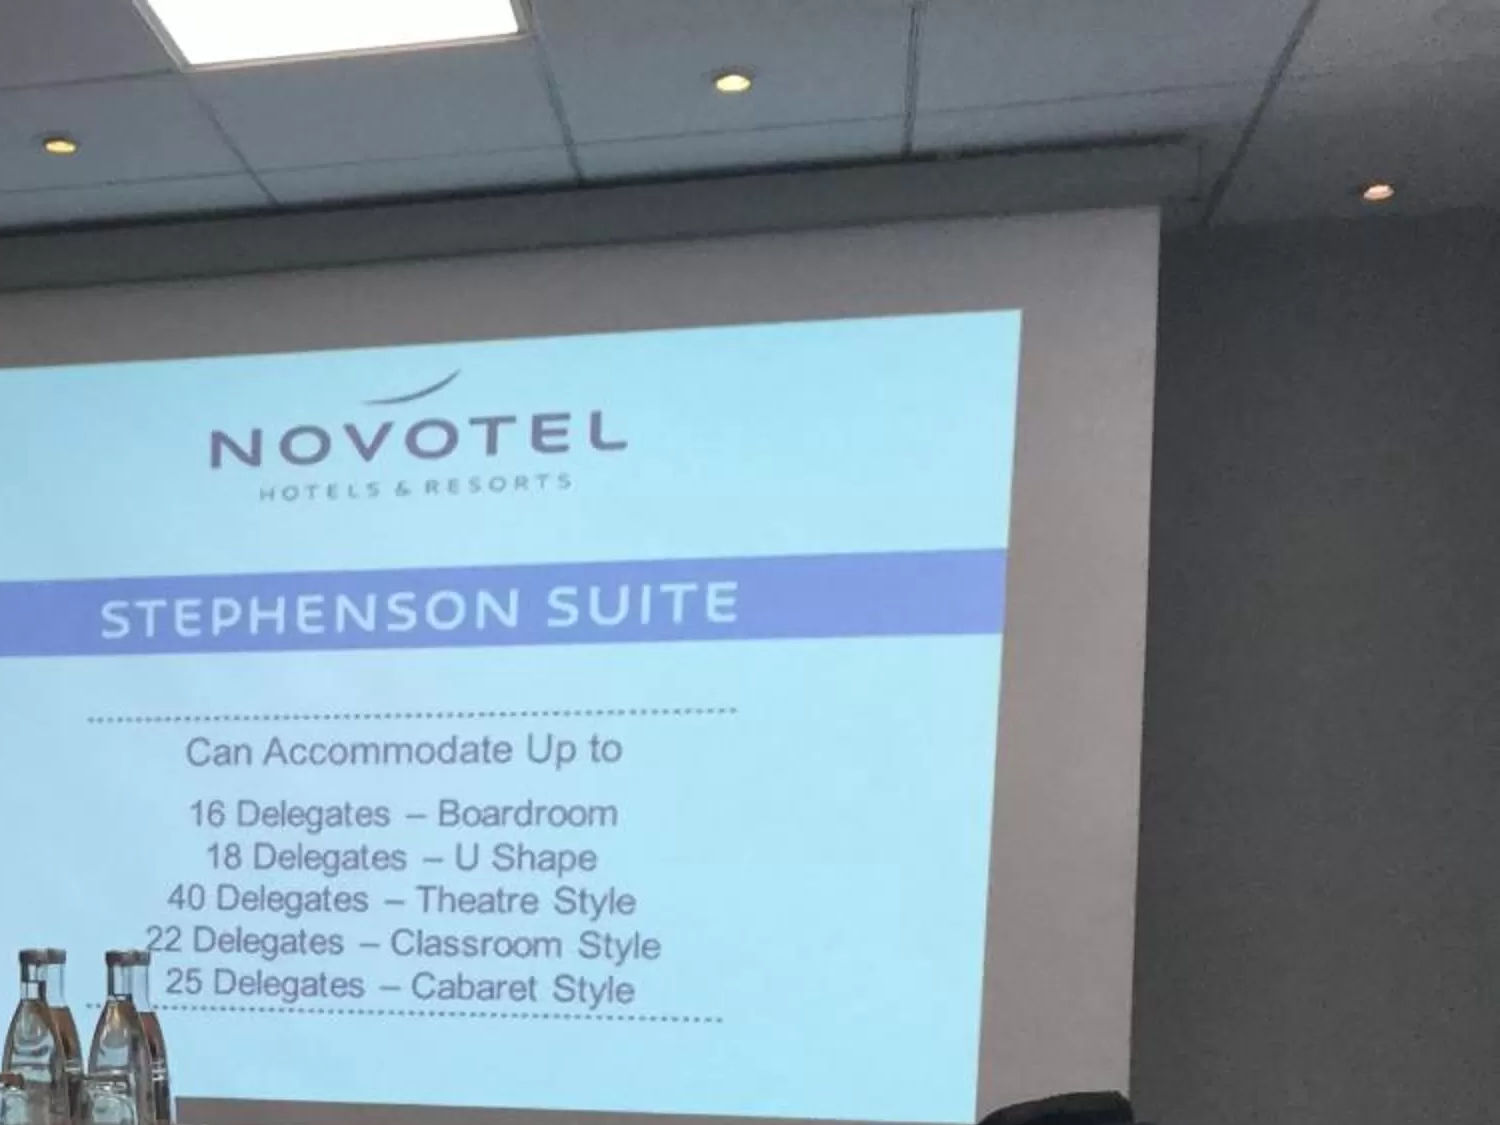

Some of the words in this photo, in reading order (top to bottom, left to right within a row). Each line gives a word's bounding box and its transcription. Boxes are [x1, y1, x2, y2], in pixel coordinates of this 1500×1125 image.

[210, 410, 629, 470] NOVOTEL
[260, 482, 381, 503] HOTELS
[394, 480, 412, 498] &
[424, 473, 573, 496] RESORTS
[100, 588, 520, 640] STEPHENSON
[546, 581, 739, 628] SUITE
[185, 736, 252, 766] Can
[261, 734, 513, 766] Accommodate
[527, 732, 577, 772] Up
[588, 733, 623, 763] to
[190, 799, 226, 827] 16
[236, 799, 391, 835] Delegates
[438, 798, 618, 828] Boardroom
[207, 841, 243, 870] 18
[253, 841, 407, 878] Delegates
[455, 842, 480, 872] U
[492, 842, 599, 878] Shape
[167, 883, 206, 910] 40
[216, 883, 369, 920] Delegates
[414, 884, 540, 915] Theatre
[553, 885, 637, 922] Style
[146, 924, 182, 950] 22
[193, 925, 344, 962] Delegates
[390, 928, 563, 959] Classroom
[577, 929, 662, 966] Style
[165, 967, 203, 994] 25
[213, 967, 366, 1004] Delegates
[411, 971, 538, 1002] Cabaret
[553, 973, 635, 1008] Style
